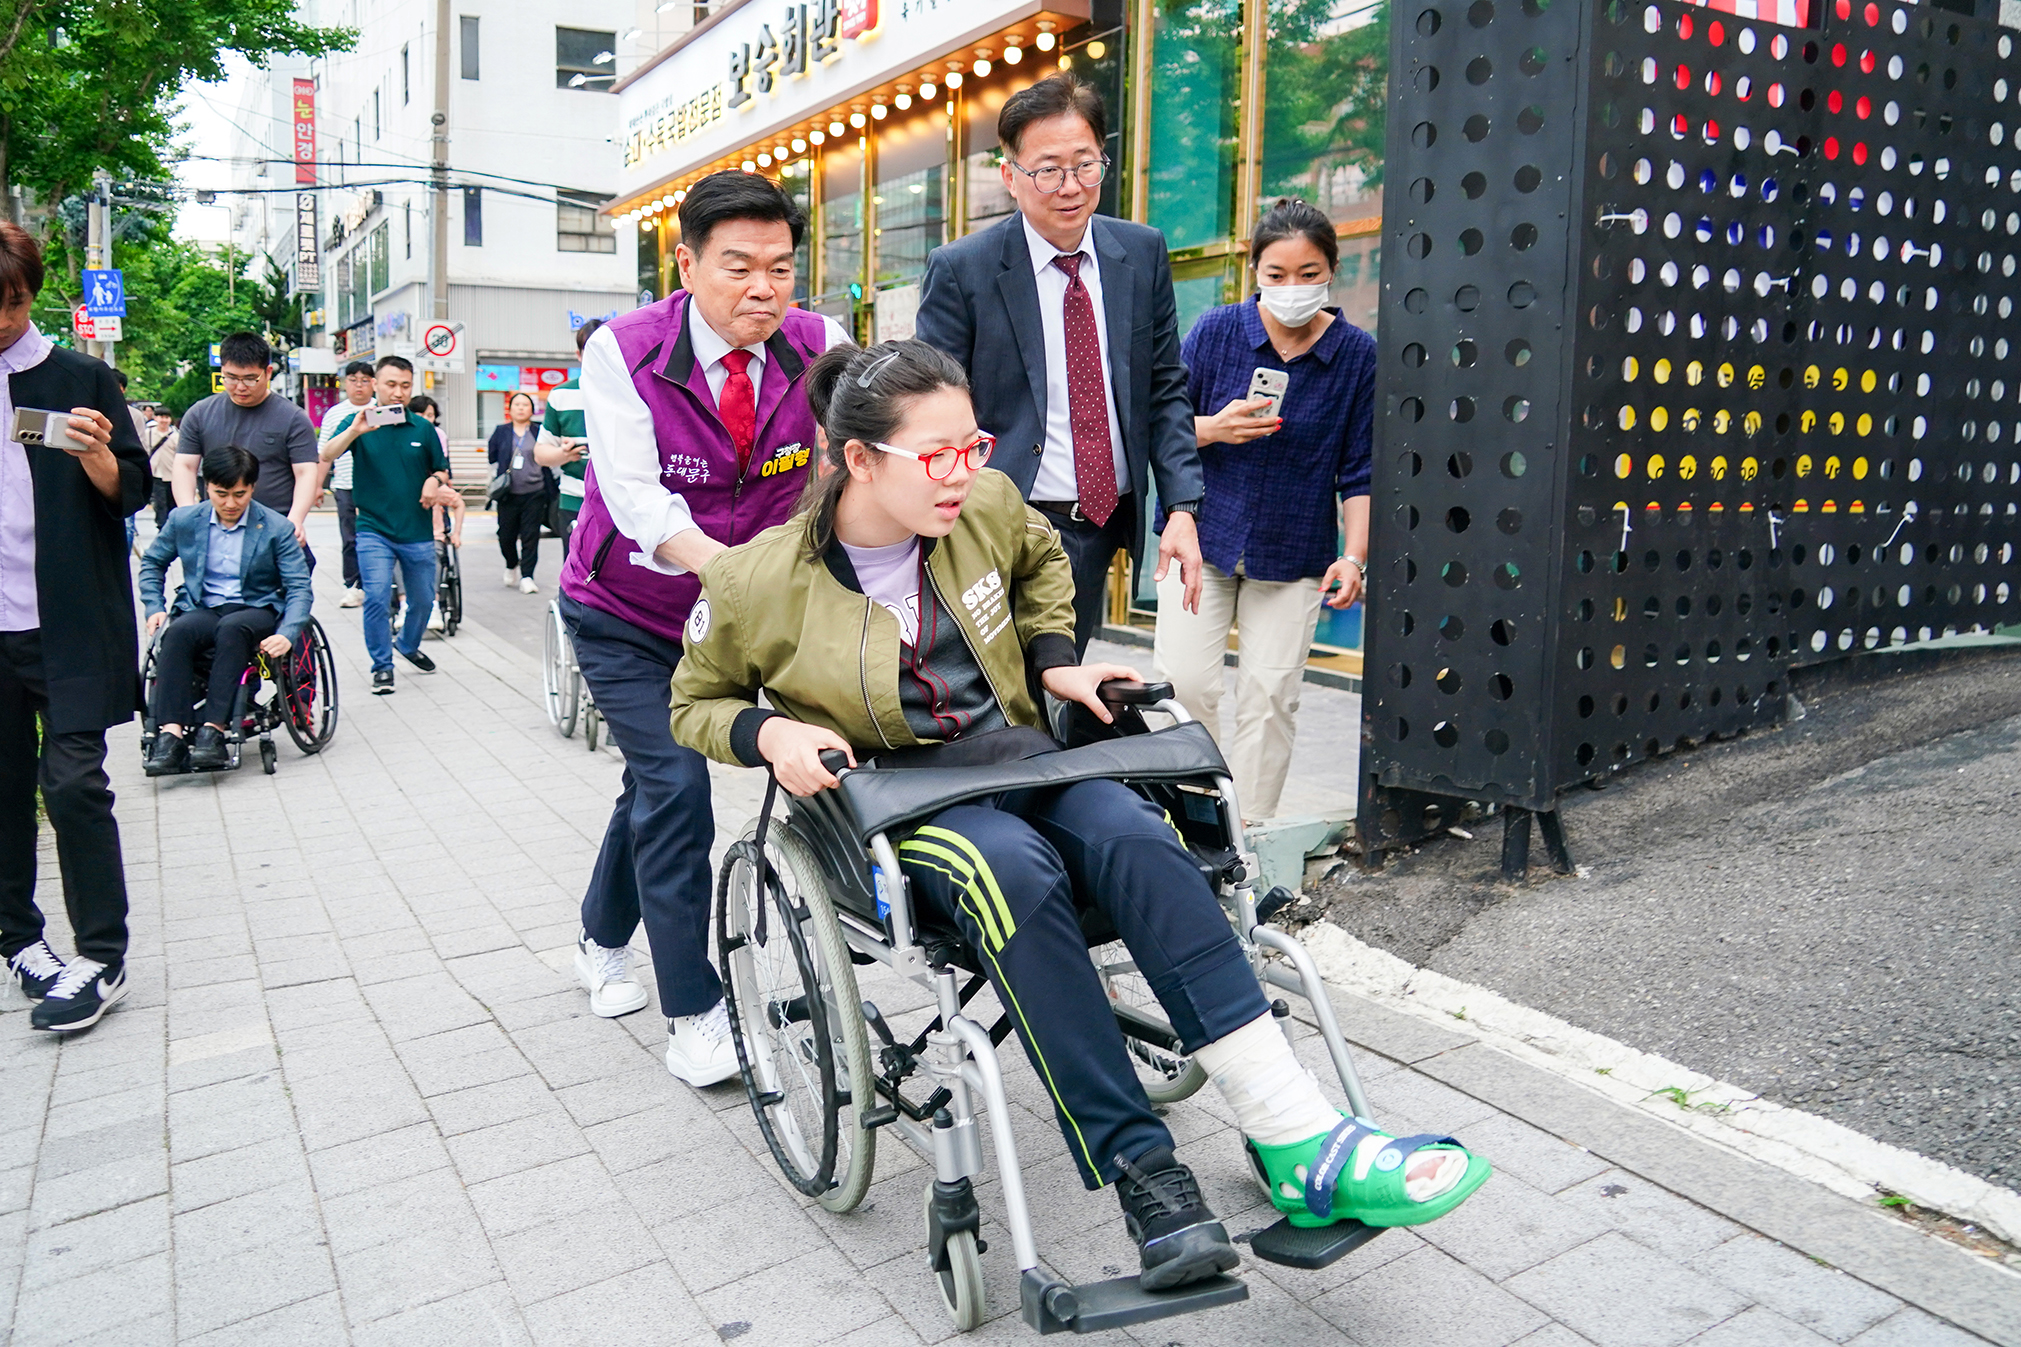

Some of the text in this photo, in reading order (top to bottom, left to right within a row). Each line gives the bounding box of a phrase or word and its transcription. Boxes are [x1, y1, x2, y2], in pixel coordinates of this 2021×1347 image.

[728, 0, 838, 108] 보승회관
[78, 324, 94, 335] STO
[663, 463, 711, 483] 동대문구
[761, 448, 811, 478] 이필형
[971, 608, 982, 620] NO
[990, 601, 1002, 617] JOY
[1325, 1142, 1342, 1164] CAST
